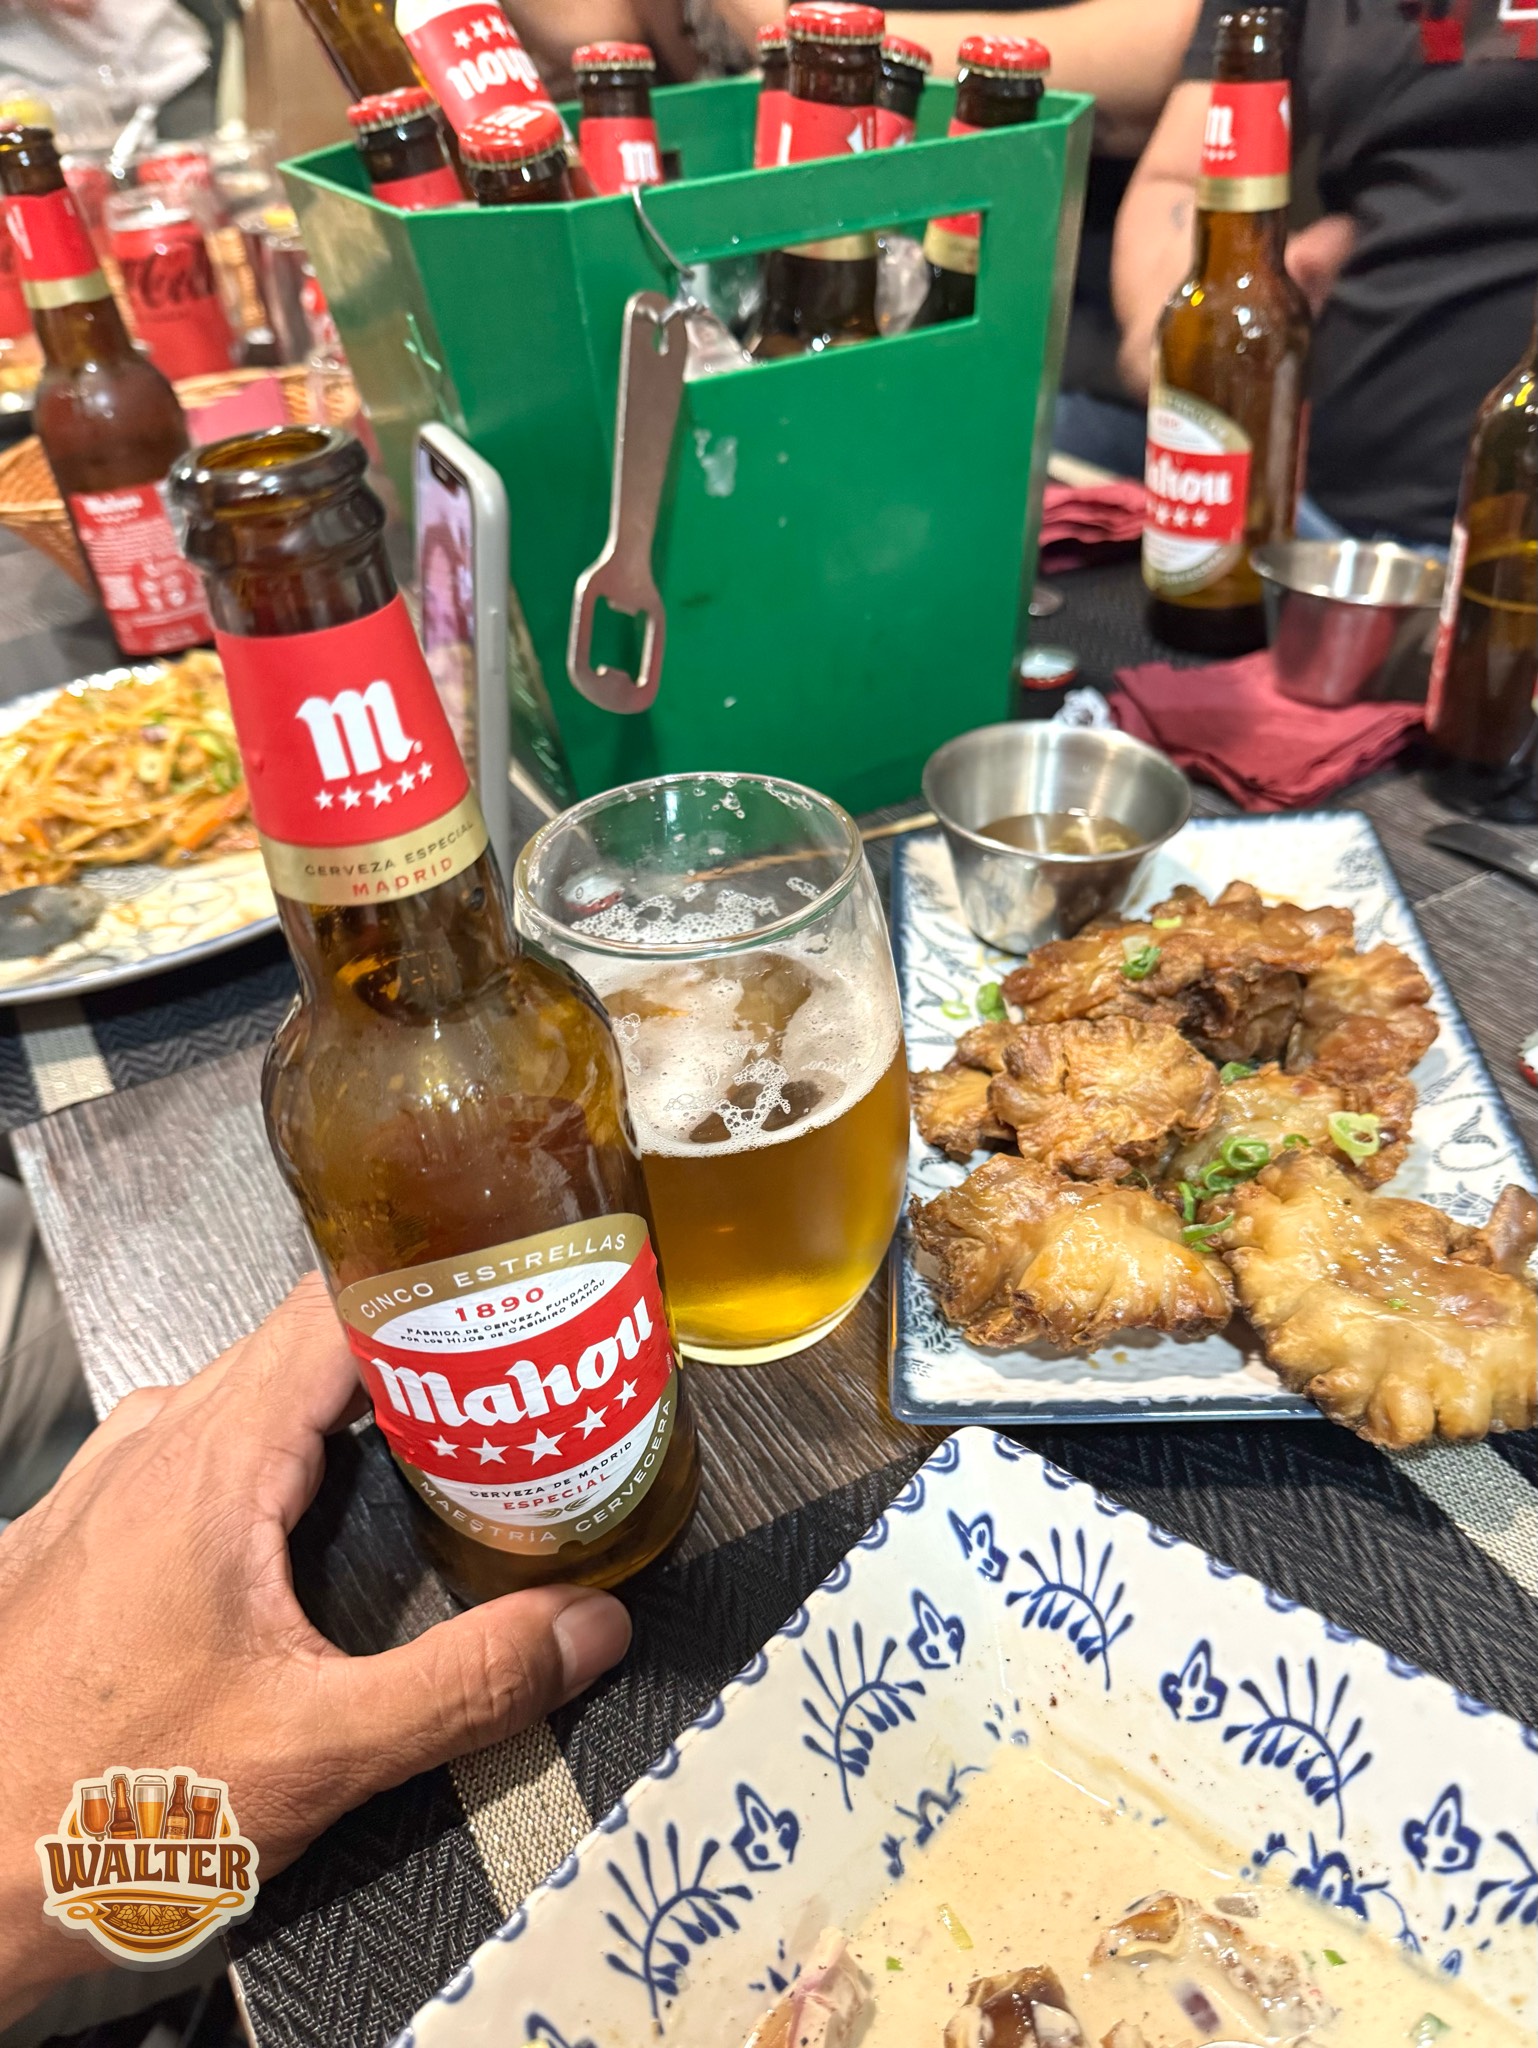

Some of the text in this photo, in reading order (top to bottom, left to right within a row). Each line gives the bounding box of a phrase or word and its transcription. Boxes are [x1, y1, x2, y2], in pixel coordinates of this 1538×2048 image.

[304, 820, 475, 877] CERVEZA ESPECIAL
[353, 857, 453, 897] MADRID
[360, 1233, 627, 1319] CINCO ESTRELLAS
[454, 1286, 545, 1322] 1890
[400, 1335, 420, 1343] POR
[446, 1335, 485, 1343] HIJOS
[508, 1306, 567, 1334] CASIMIRO
[570, 1279, 606, 1308] MAHOU
[465, 1327, 480, 1335] DE
[483, 1310, 542, 1332] CERVEZA
[545, 1278, 597, 1311] FUNDADA
[370, 1296, 654, 1427] Mahou
[469, 1441, 633, 1499] CERVEZA DE MADRID
[503, 1473, 612, 1511] ESPECIAL
[574, 1400, 672, 1533] CERVECERA
